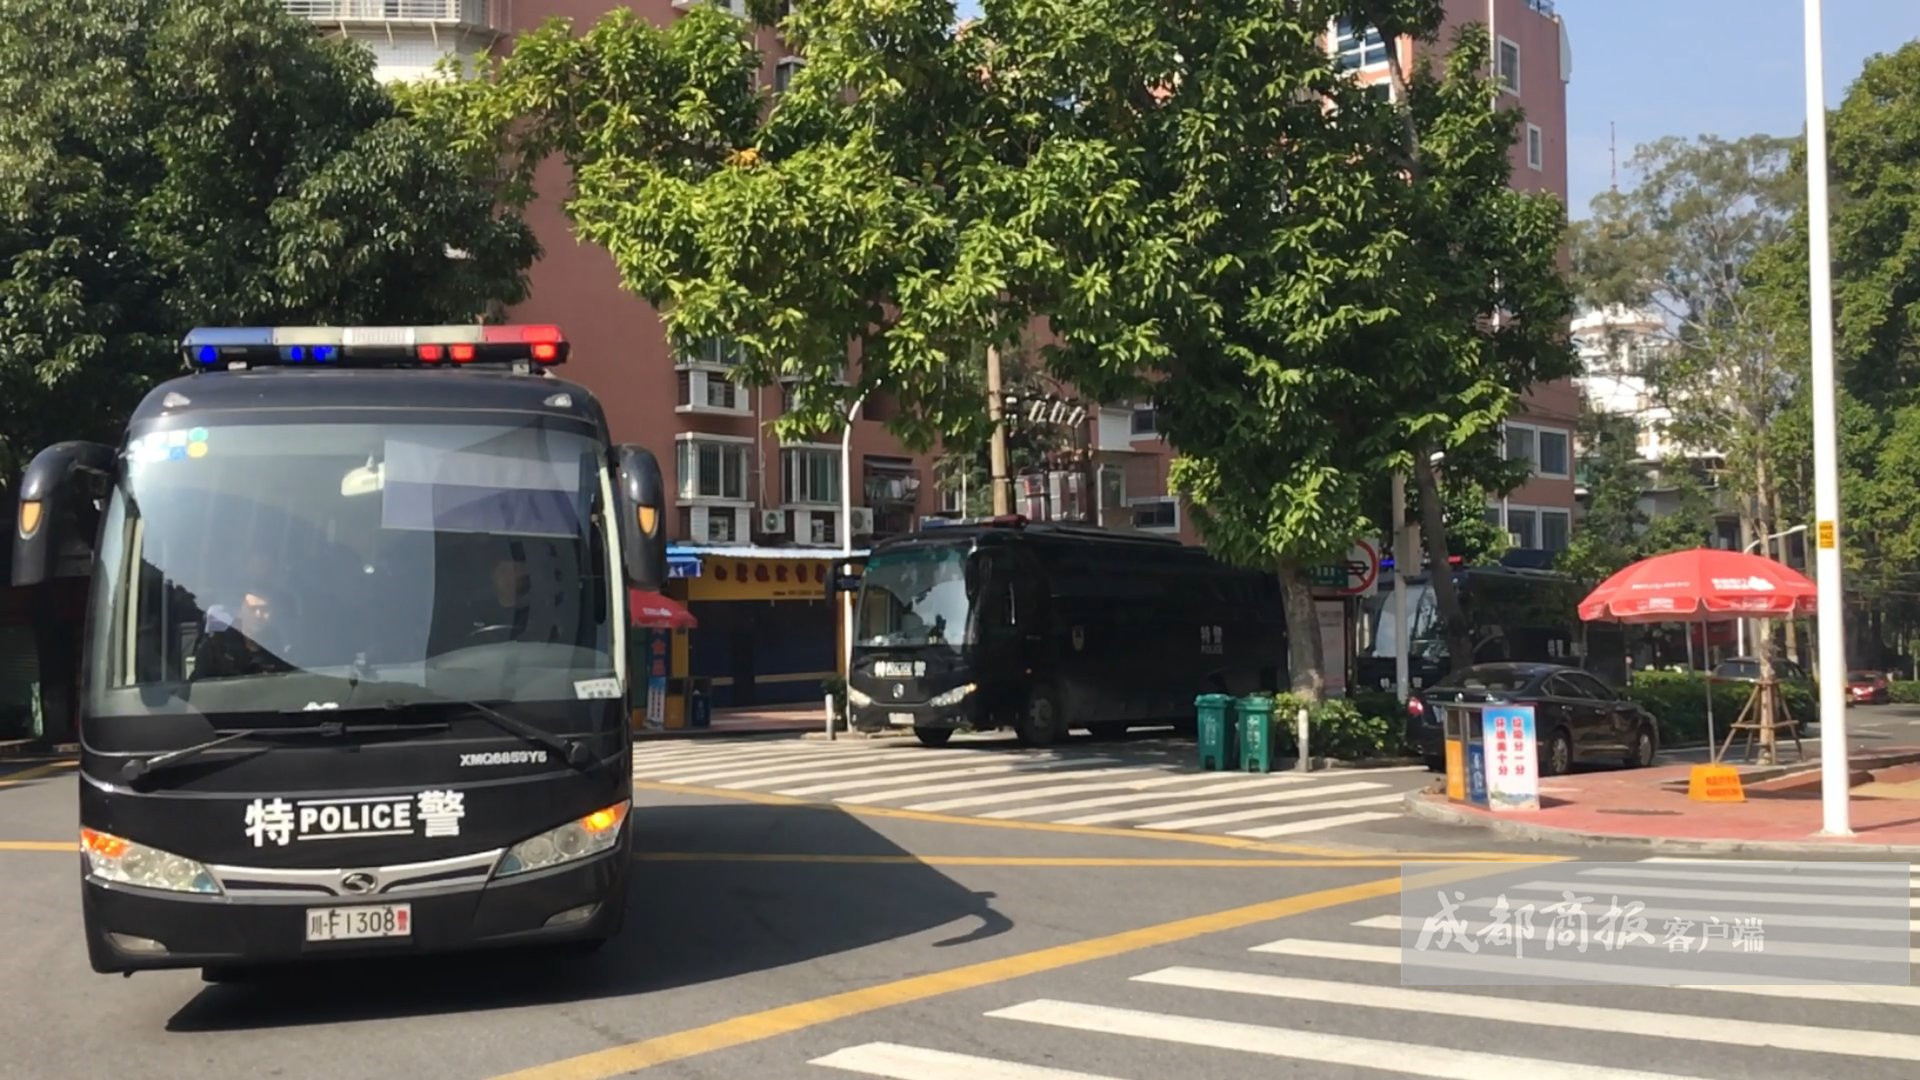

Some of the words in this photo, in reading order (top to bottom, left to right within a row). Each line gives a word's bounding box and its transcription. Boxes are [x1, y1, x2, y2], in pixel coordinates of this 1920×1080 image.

[244, 798, 295, 847] 特
[300, 803, 411, 833] POLICE
[417, 789, 465, 837] 警
